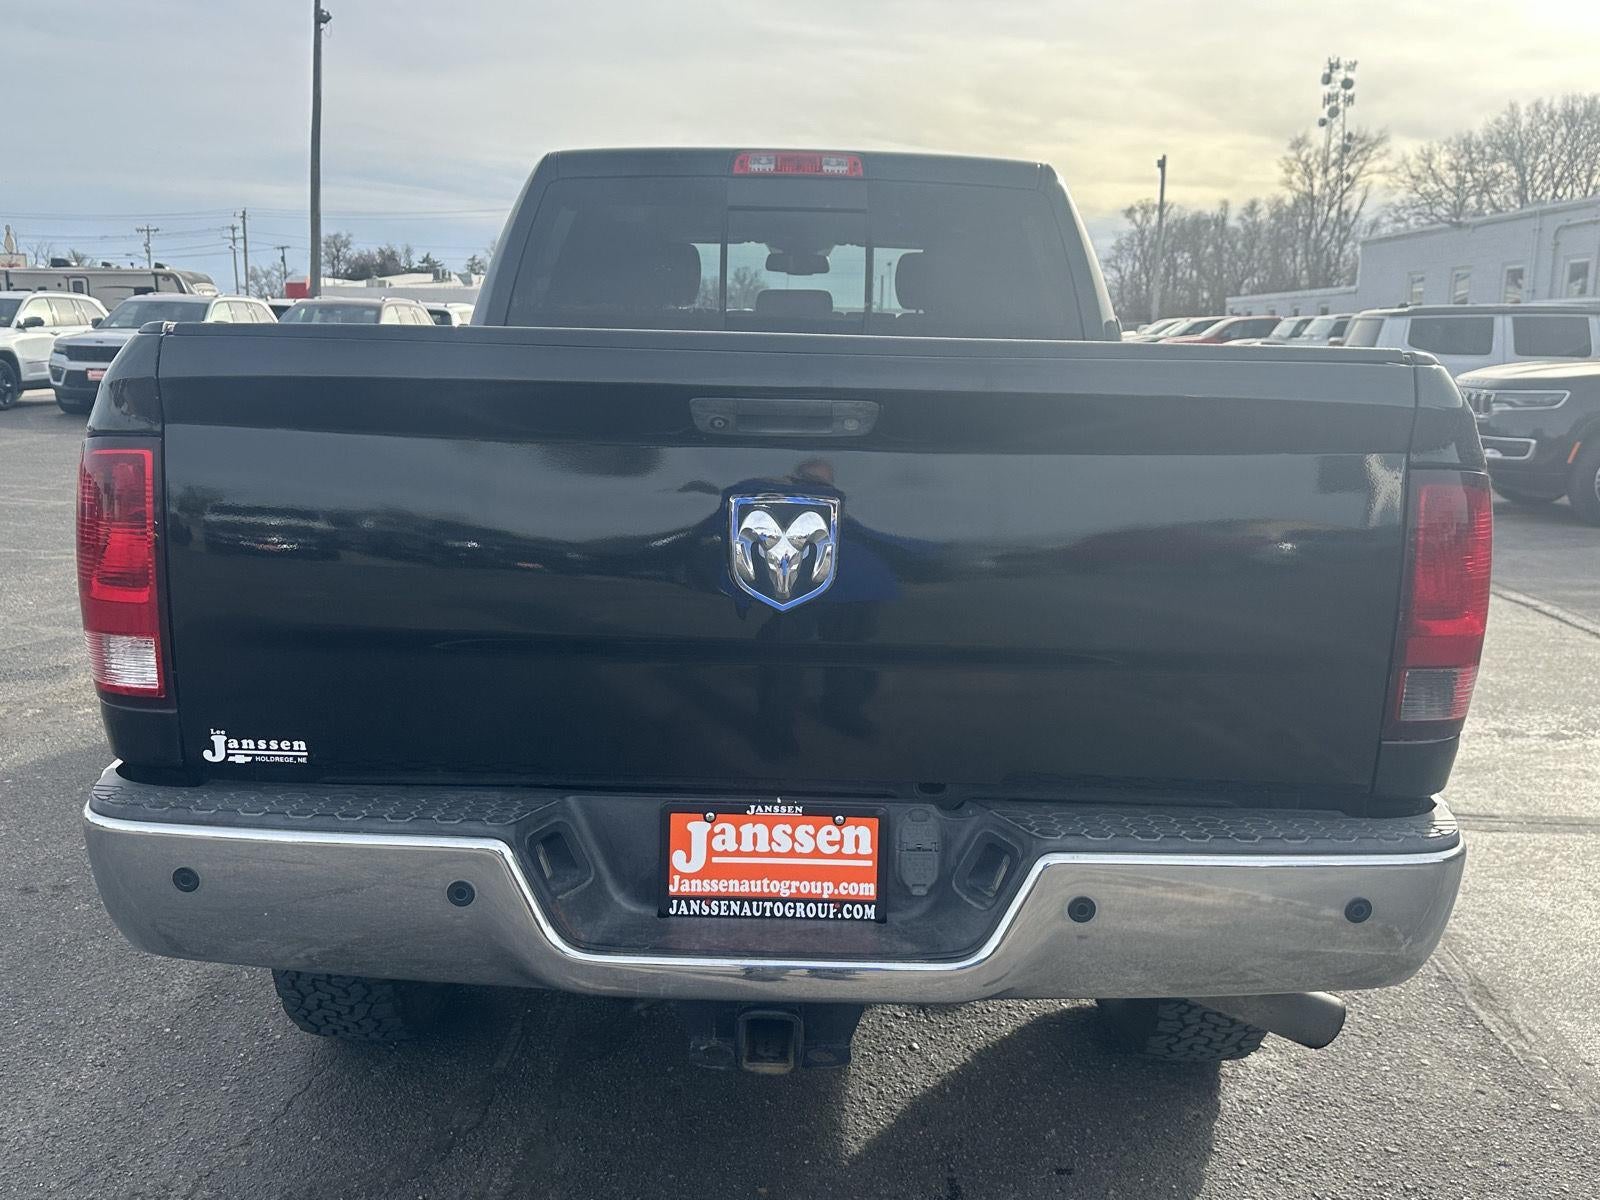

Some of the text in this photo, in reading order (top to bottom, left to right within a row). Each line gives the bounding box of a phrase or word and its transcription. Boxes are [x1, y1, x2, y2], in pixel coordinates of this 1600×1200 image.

[202, 734, 307, 763] Janssen
[255, 755, 308, 764] HOLDREGE, NE
[746, 804, 803, 815] JANSSEN
[671, 820, 873, 873] Janssen
[668, 874, 875, 898] Janssenautogroup.com
[668, 899, 876, 920] JANSSENAUTOGROUP.COM
